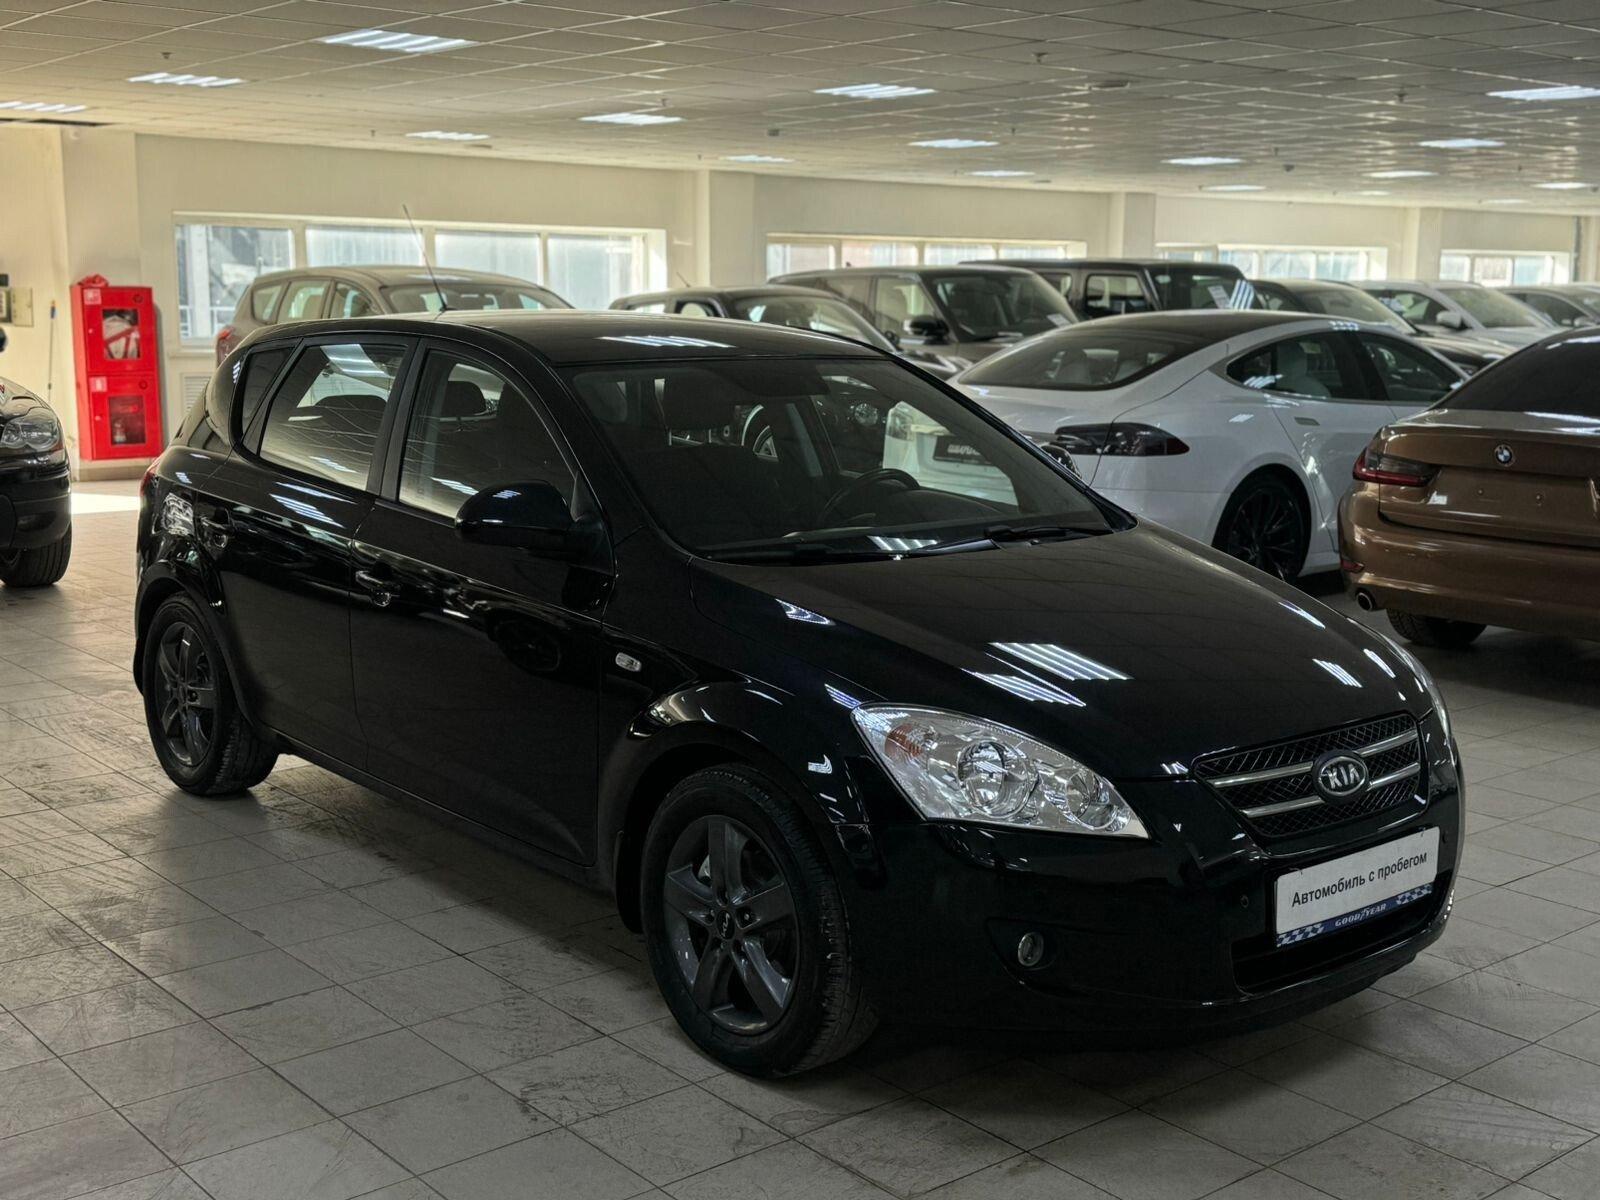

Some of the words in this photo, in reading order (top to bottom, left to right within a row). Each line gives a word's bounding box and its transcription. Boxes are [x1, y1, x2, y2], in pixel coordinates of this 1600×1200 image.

[1327, 763, 1361, 789] KIA
[1292, 874, 1366, 907] Автомобиль
[1368, 870, 1375, 882] с
[1377, 852, 1427, 880] пробегом
